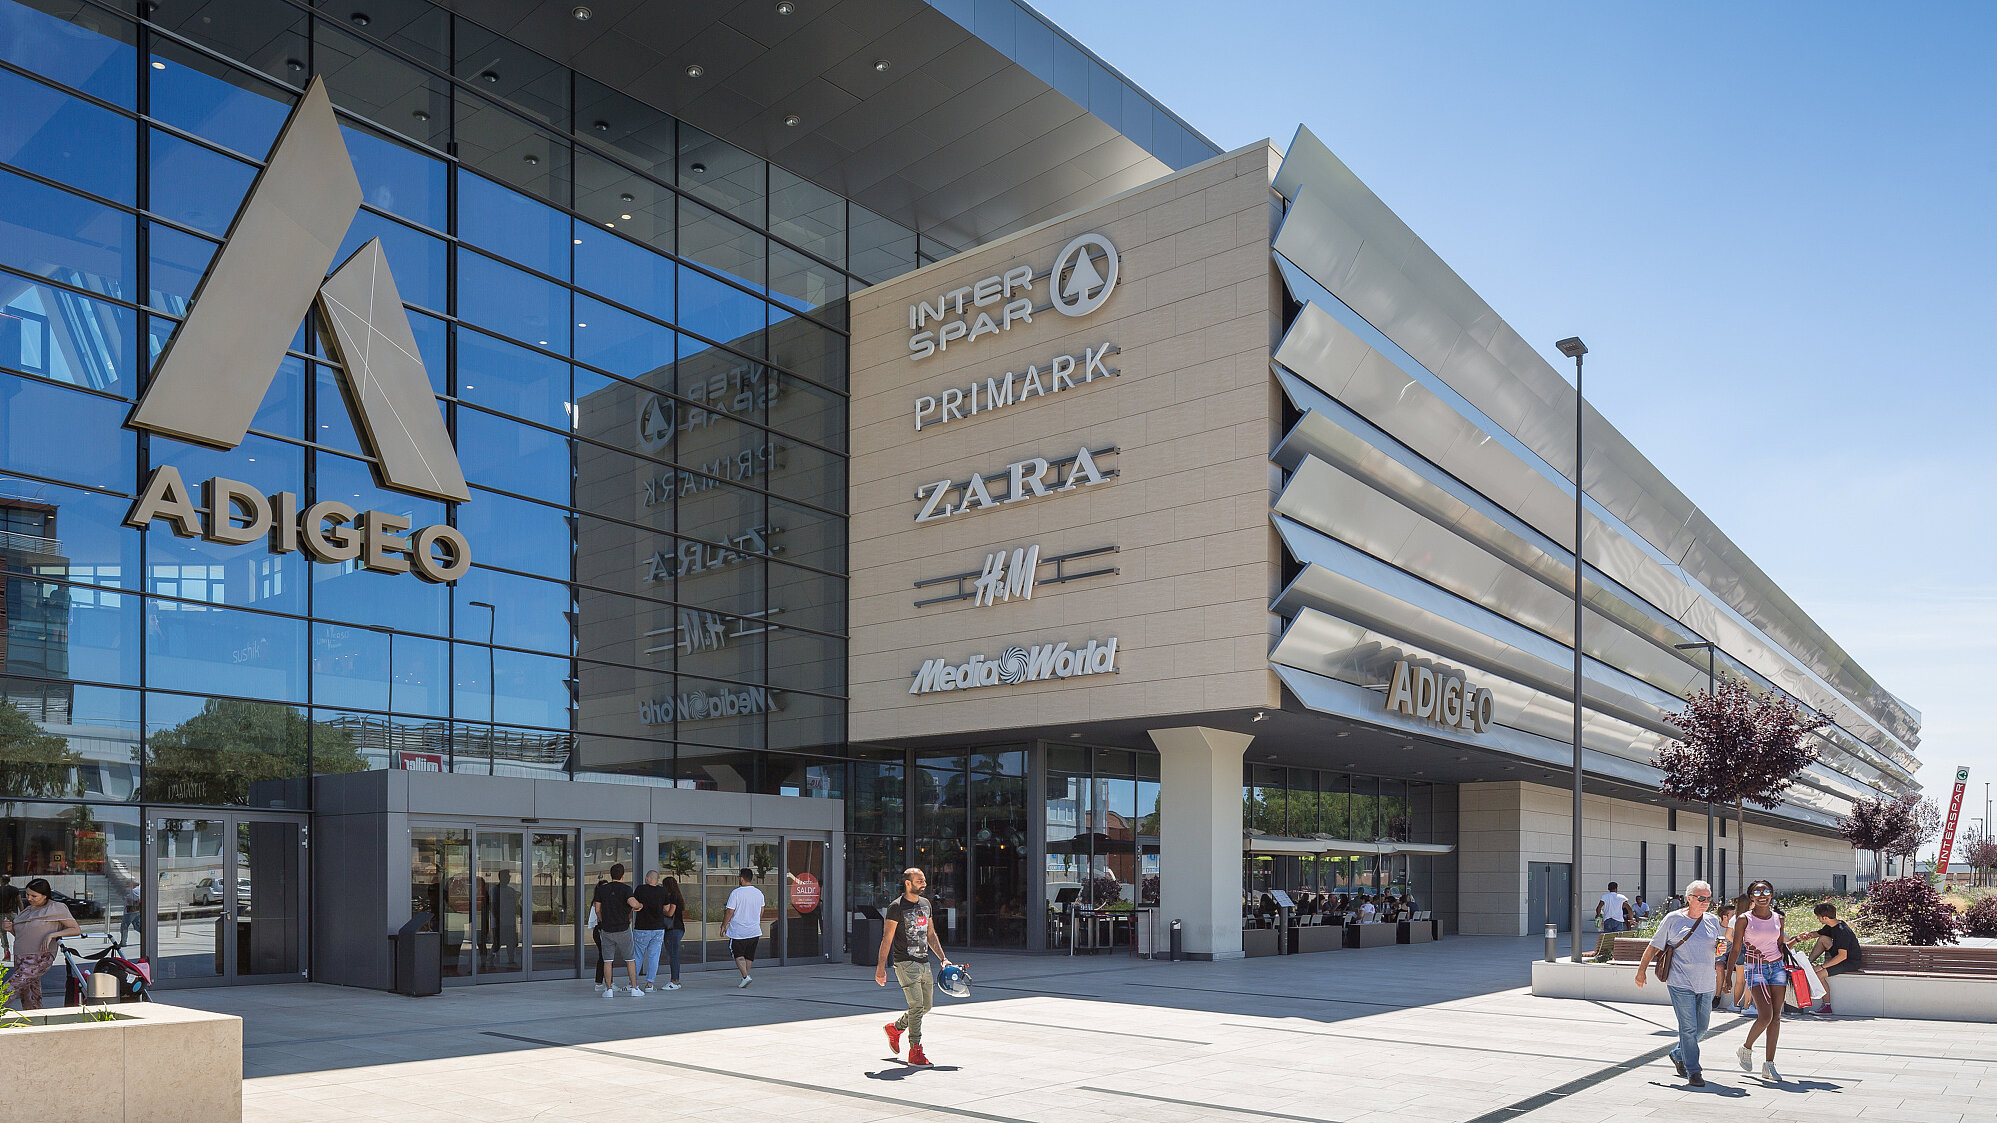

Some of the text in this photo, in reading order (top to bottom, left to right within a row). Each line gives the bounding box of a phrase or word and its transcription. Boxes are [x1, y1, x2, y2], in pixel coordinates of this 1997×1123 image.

[908, 298, 1033, 361] SPAR
[909, 265, 1033, 330] INTER
[915, 342, 1110, 431] PRIMARK
[915, 447, 1110, 523] ZARA
[121, 464, 472, 584] ADIGEO
[974, 544, 1040, 607] H&M
[1384, 660, 1495, 734] ADIGEO
[1940, 783, 1964, 863] INTERSPAR
